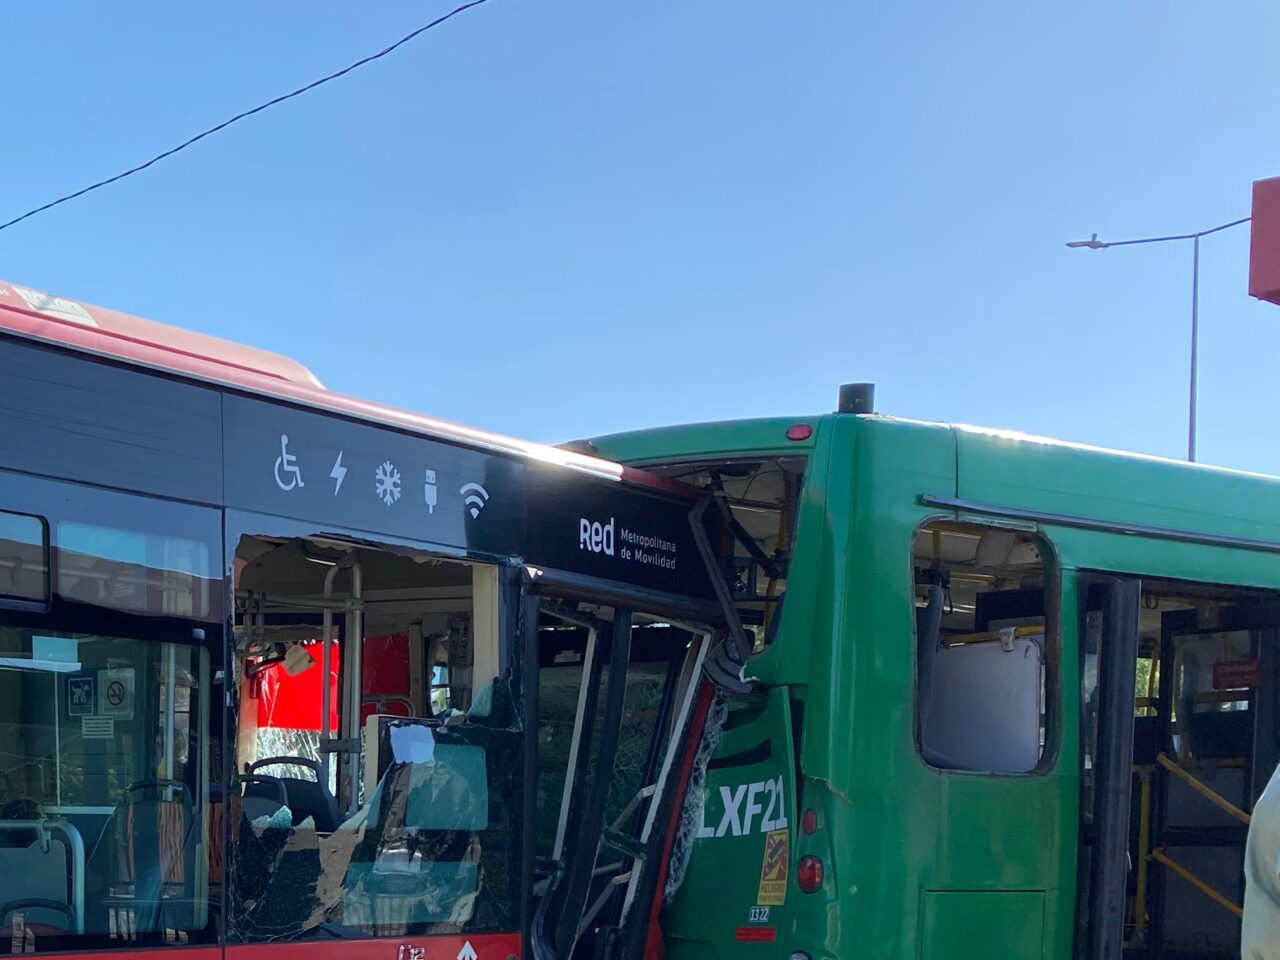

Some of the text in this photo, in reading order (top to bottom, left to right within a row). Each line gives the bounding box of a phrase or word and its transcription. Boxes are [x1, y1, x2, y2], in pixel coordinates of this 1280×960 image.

[579, 516, 615, 557] Red
[620, 527, 677, 553] Metropolitana
[620, 545, 676, 569] de Movilidad
